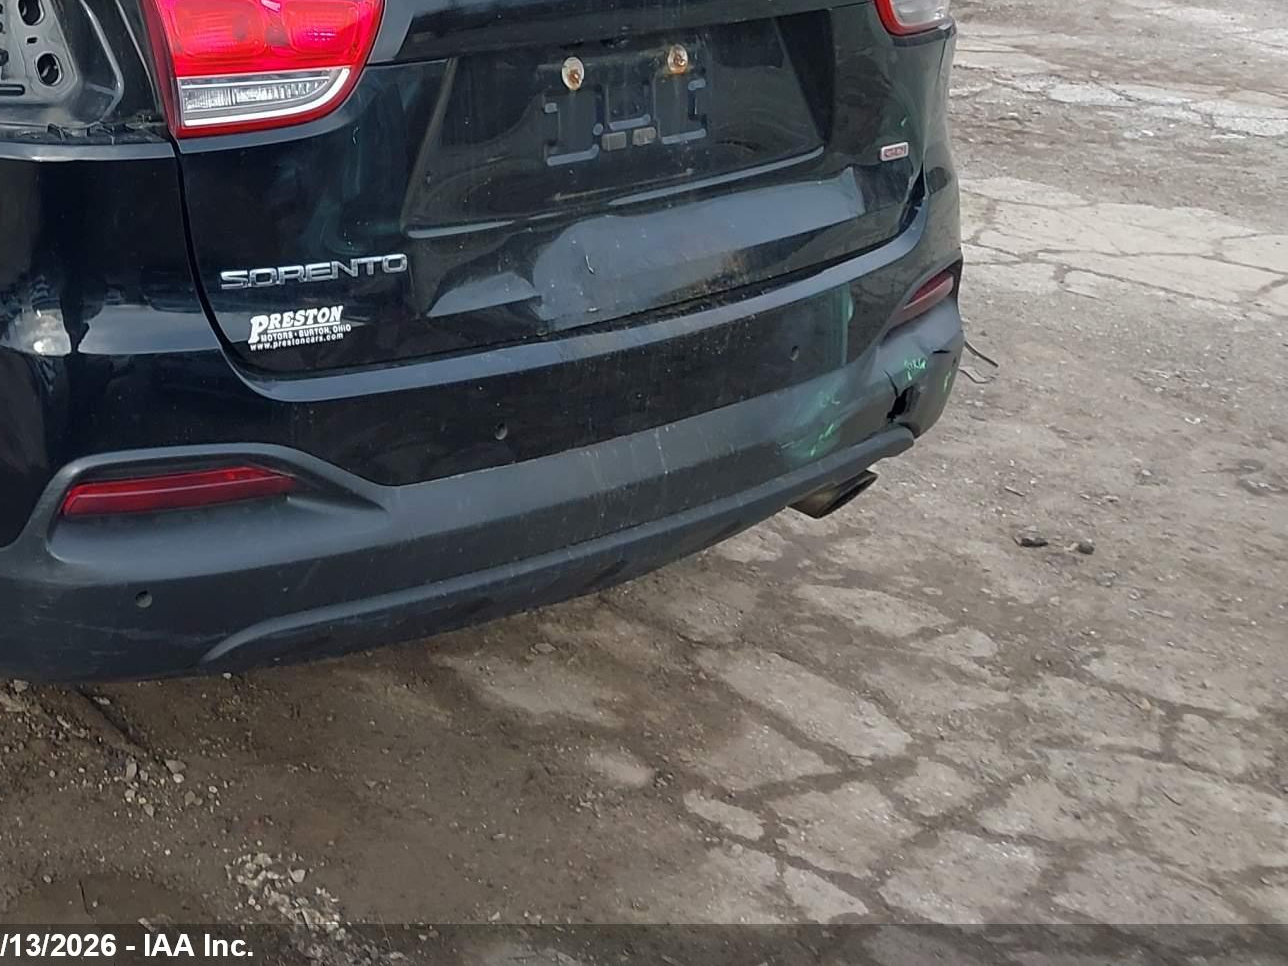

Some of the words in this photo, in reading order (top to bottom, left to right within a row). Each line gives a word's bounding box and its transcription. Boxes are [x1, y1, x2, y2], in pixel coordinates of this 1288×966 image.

[220, 253, 409, 290] SORENTO
[247, 305, 344, 344] PRESTON
[260, 328, 293, 342] MOTORS
[332, 324, 352, 335] OHIO
[249, 332, 344, 352] www.prestoncars.com
